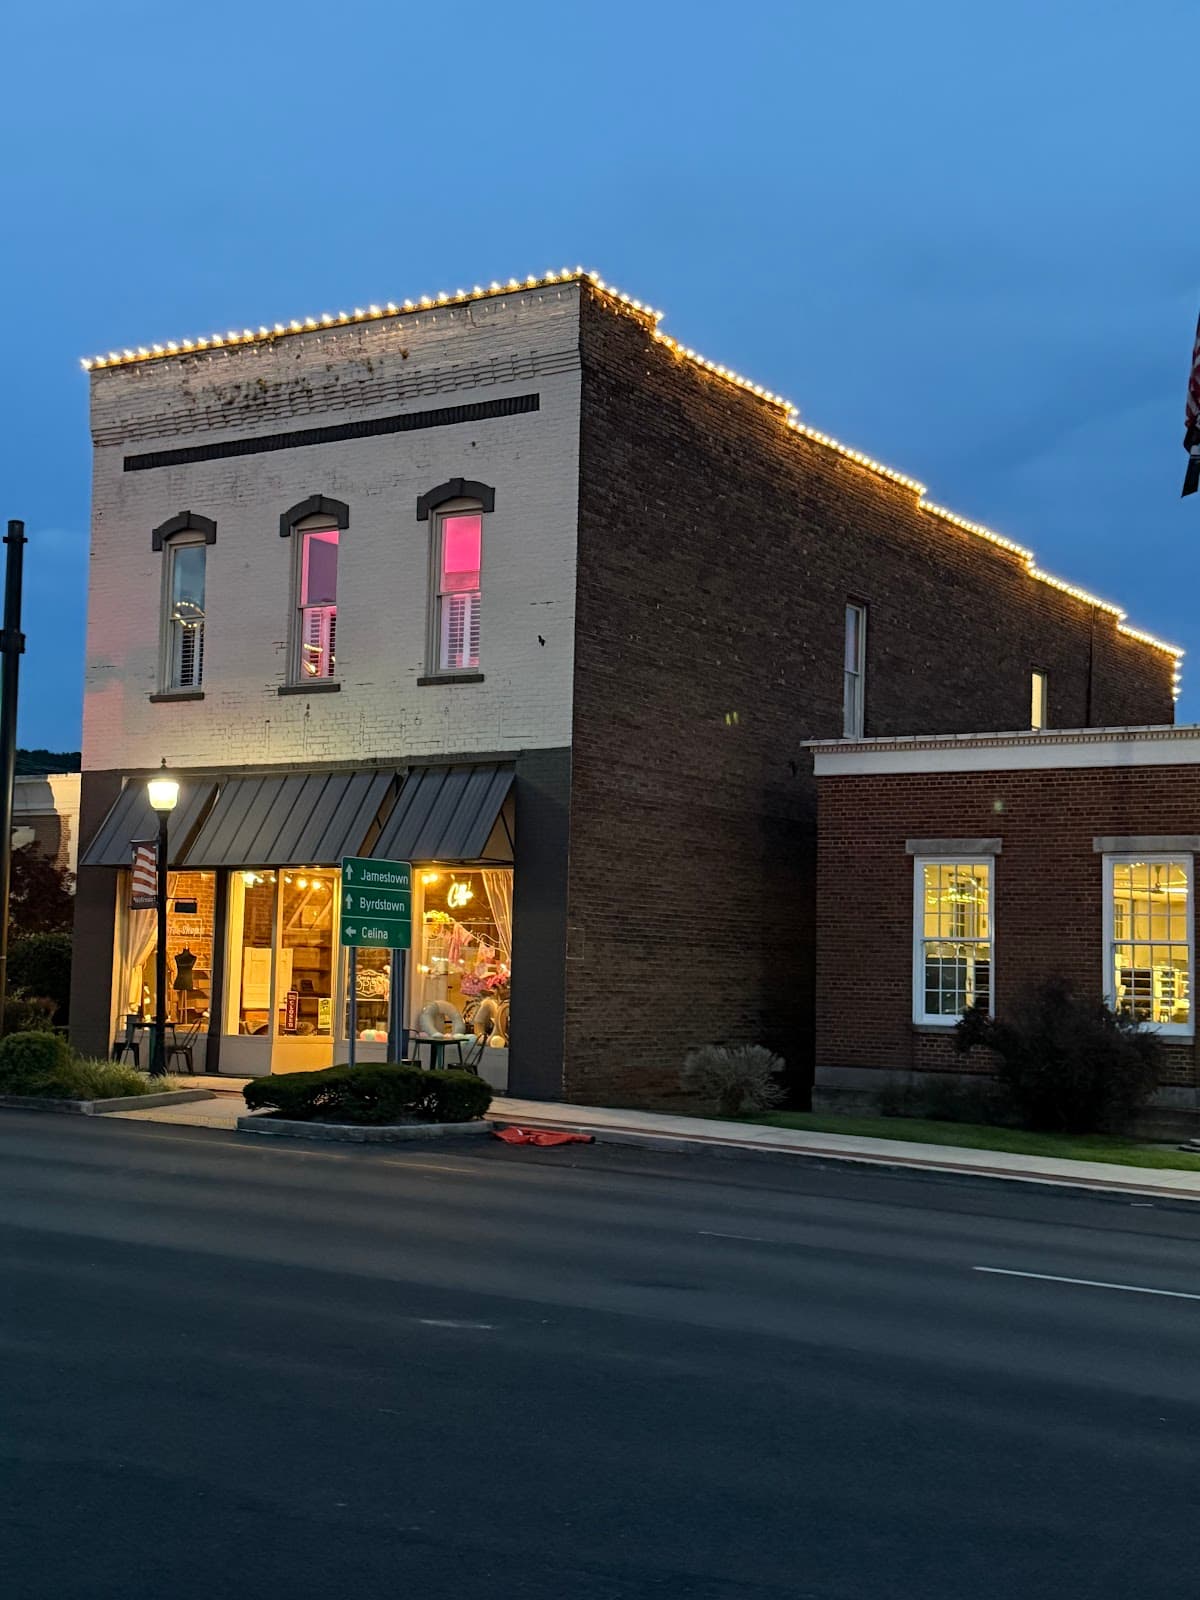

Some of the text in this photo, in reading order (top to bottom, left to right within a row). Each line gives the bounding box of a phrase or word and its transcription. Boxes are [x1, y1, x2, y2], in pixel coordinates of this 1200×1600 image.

[360, 869, 409, 885] Jamestown
[359, 897, 405, 912] Byrdstown
[361, 926, 389, 940] Celina
